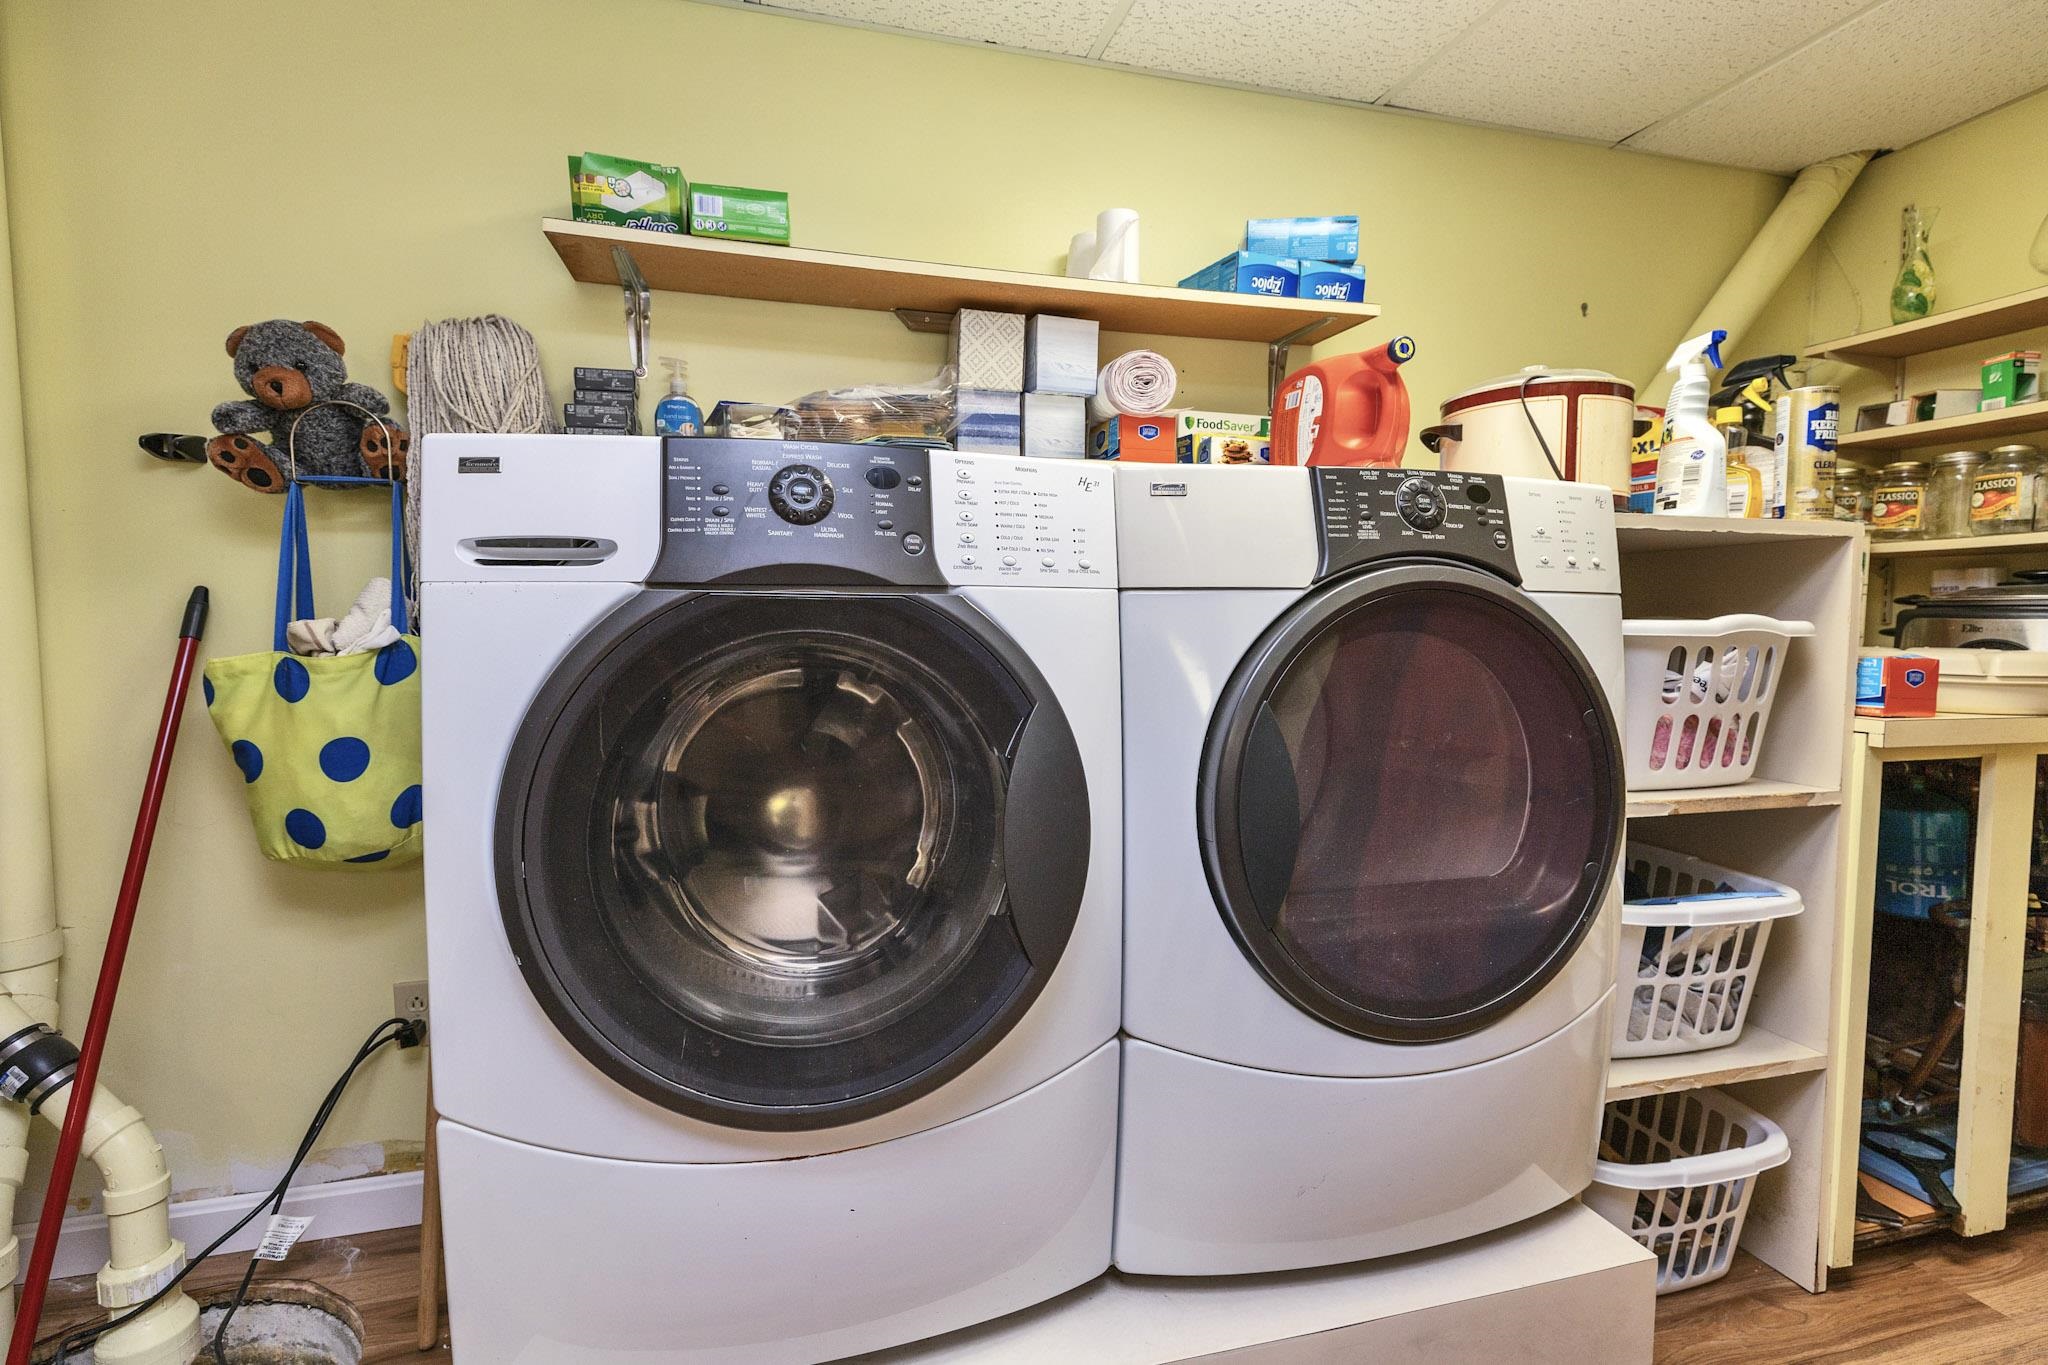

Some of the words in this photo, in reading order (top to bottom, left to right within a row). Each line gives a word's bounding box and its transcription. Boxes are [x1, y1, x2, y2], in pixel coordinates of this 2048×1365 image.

[1251, 276, 1283, 294] Ziploc
[1315, 282, 1347, 299] Ziploc
[1196, 418, 1256, 434] FoodSaver
[1974, 478, 2017, 491] CLASSICO
[1877, 491, 1919, 502] CLASSICO
[767, 529, 793, 537] SANITARY
[814, 531, 844, 539] HANDWASH
[1961, 624, 1984, 633] Elite
